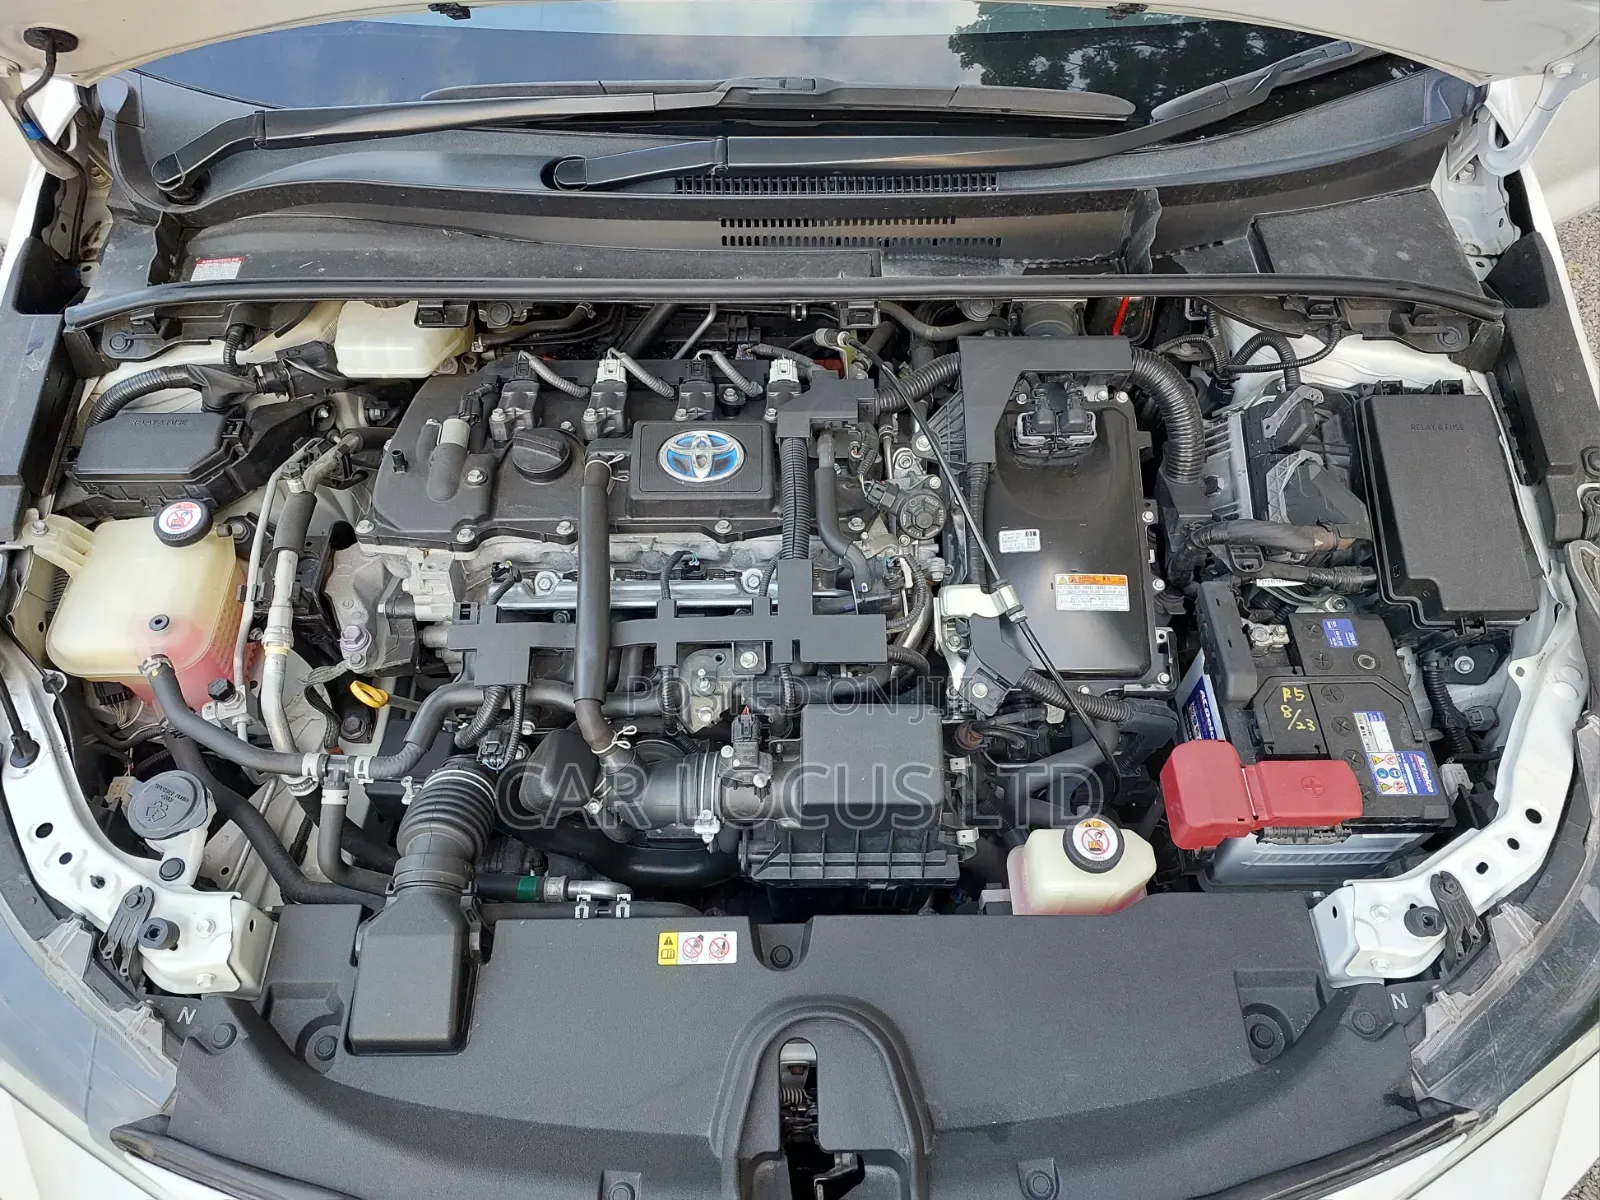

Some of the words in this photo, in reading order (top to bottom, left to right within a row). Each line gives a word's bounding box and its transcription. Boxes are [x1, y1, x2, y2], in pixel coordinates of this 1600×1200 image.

[1410, 423, 1435, 431] RELAY
[1445, 423, 1465, 431] FUSE
[1282, 686, 1305, 702] R5
[1199, 689, 1215, 740] ACDelc
[1280, 704, 1316, 732] 8/23
[1414, 753, 1434, 793] ACDelco
[1390, 992, 1408, 1010] N
[176, 1006, 197, 1025] N
